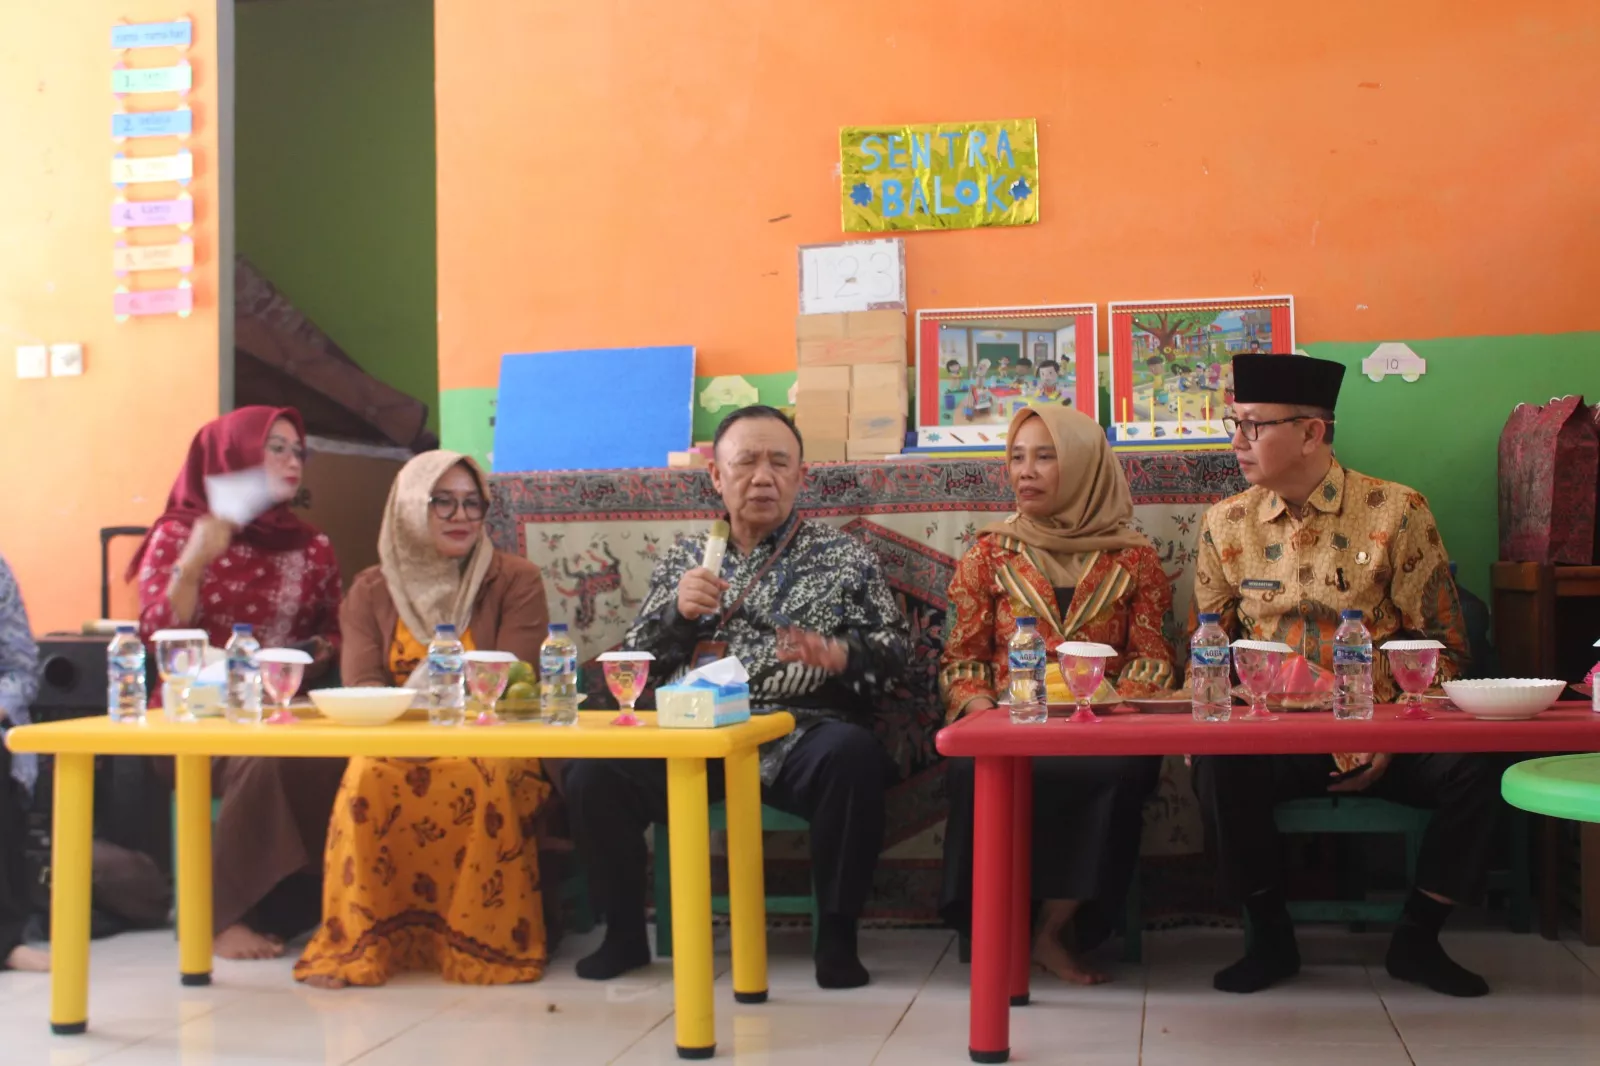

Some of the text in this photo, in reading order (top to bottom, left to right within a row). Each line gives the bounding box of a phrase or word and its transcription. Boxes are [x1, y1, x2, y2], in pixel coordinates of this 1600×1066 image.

[860, 129, 1015, 171] SENTRA
[882, 174, 1008, 217] BALOK
[1386, 358, 1399, 370] 10
